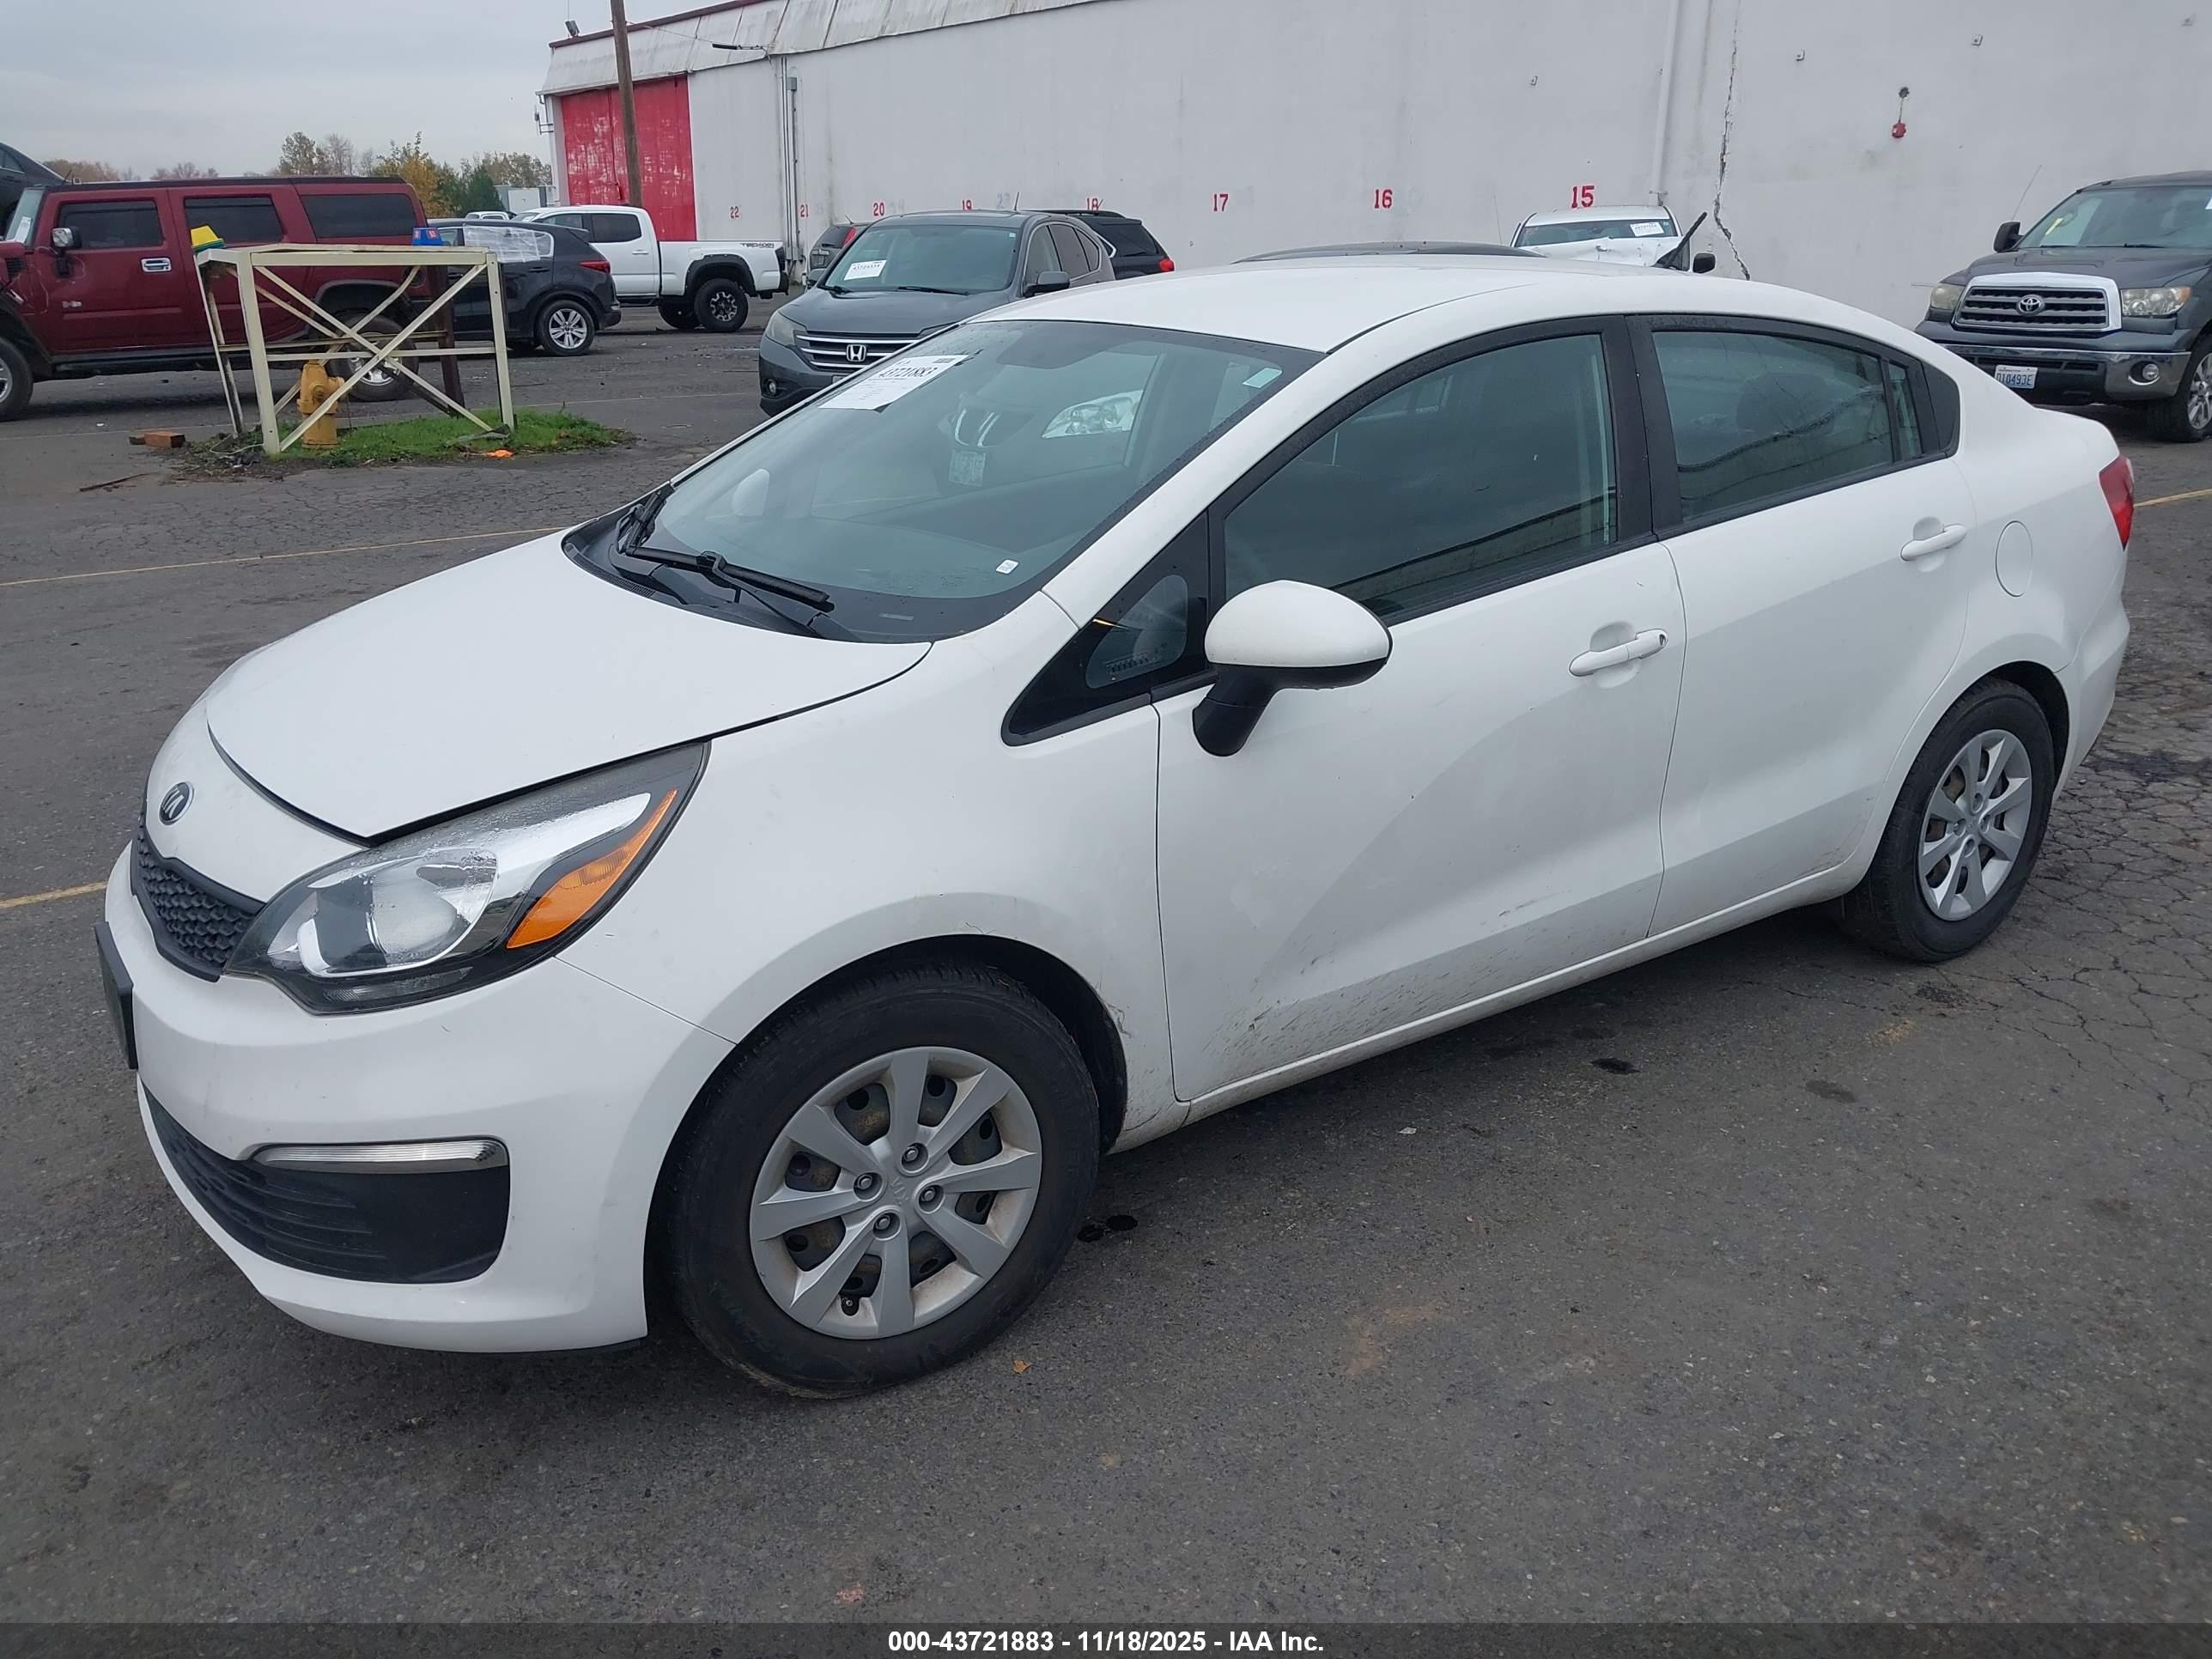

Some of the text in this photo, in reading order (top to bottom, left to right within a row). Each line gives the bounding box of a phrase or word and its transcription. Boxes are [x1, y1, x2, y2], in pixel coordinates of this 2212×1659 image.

[1213, 193, 1229, 212] 17
[1374, 189, 1393, 209] 16
[1571, 185, 1595, 208] 15
[799, 204, 809, 217] 21
[872, 202, 885, 216] 20
[962, 200, 972, 210] 19
[730, 206, 739, 219] 22
